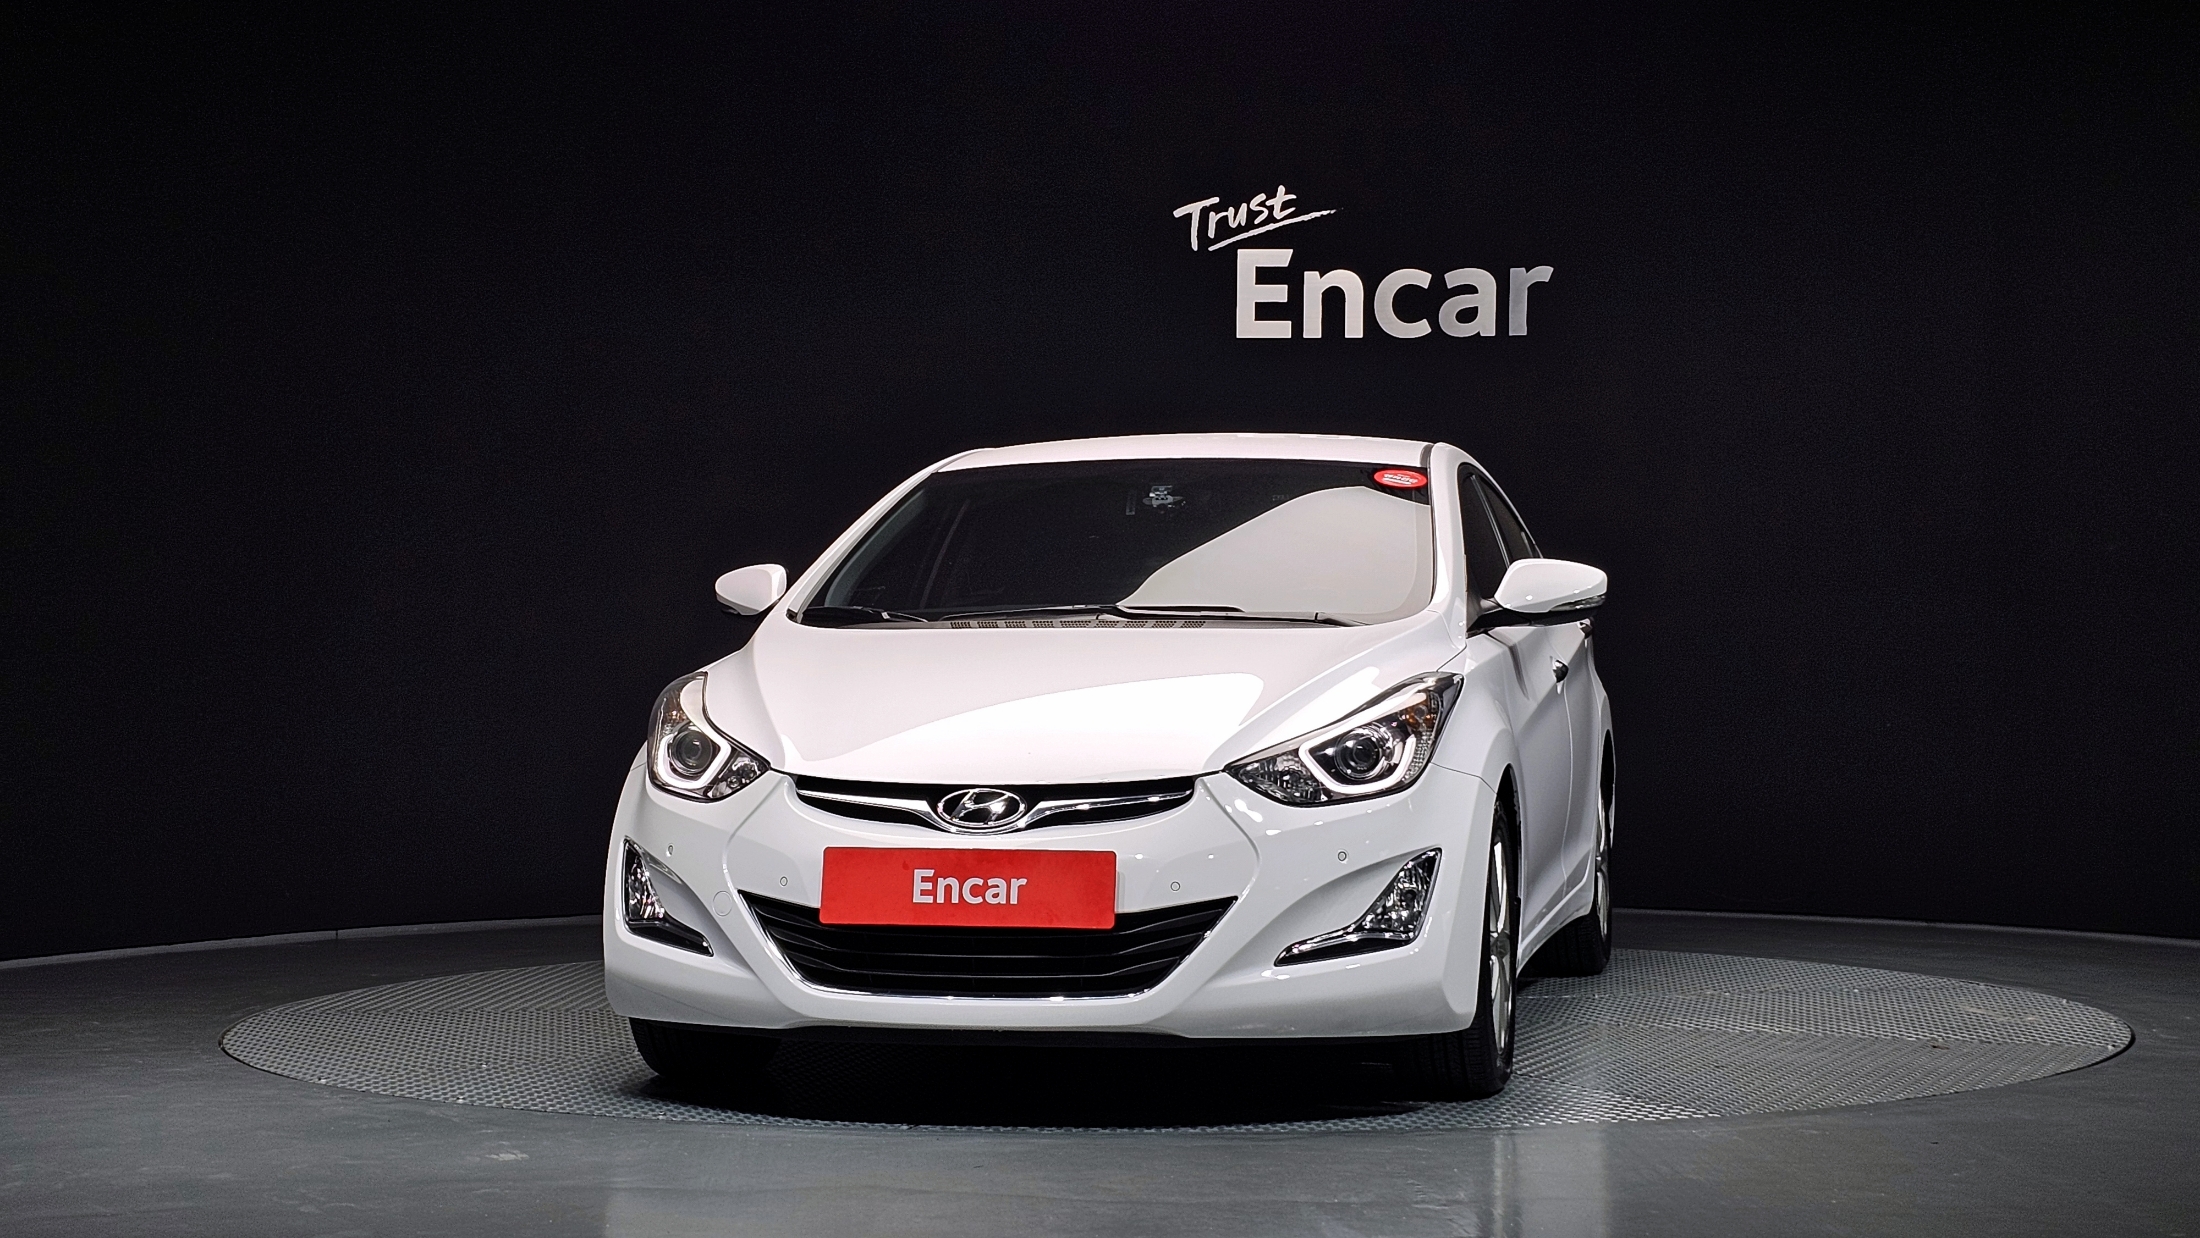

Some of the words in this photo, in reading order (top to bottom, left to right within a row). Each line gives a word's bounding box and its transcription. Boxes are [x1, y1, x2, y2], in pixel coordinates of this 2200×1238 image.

[1173, 184, 1297, 251] Trust
[1235, 248, 1554, 339] Encar
[912, 868, 1028, 905] Encar
